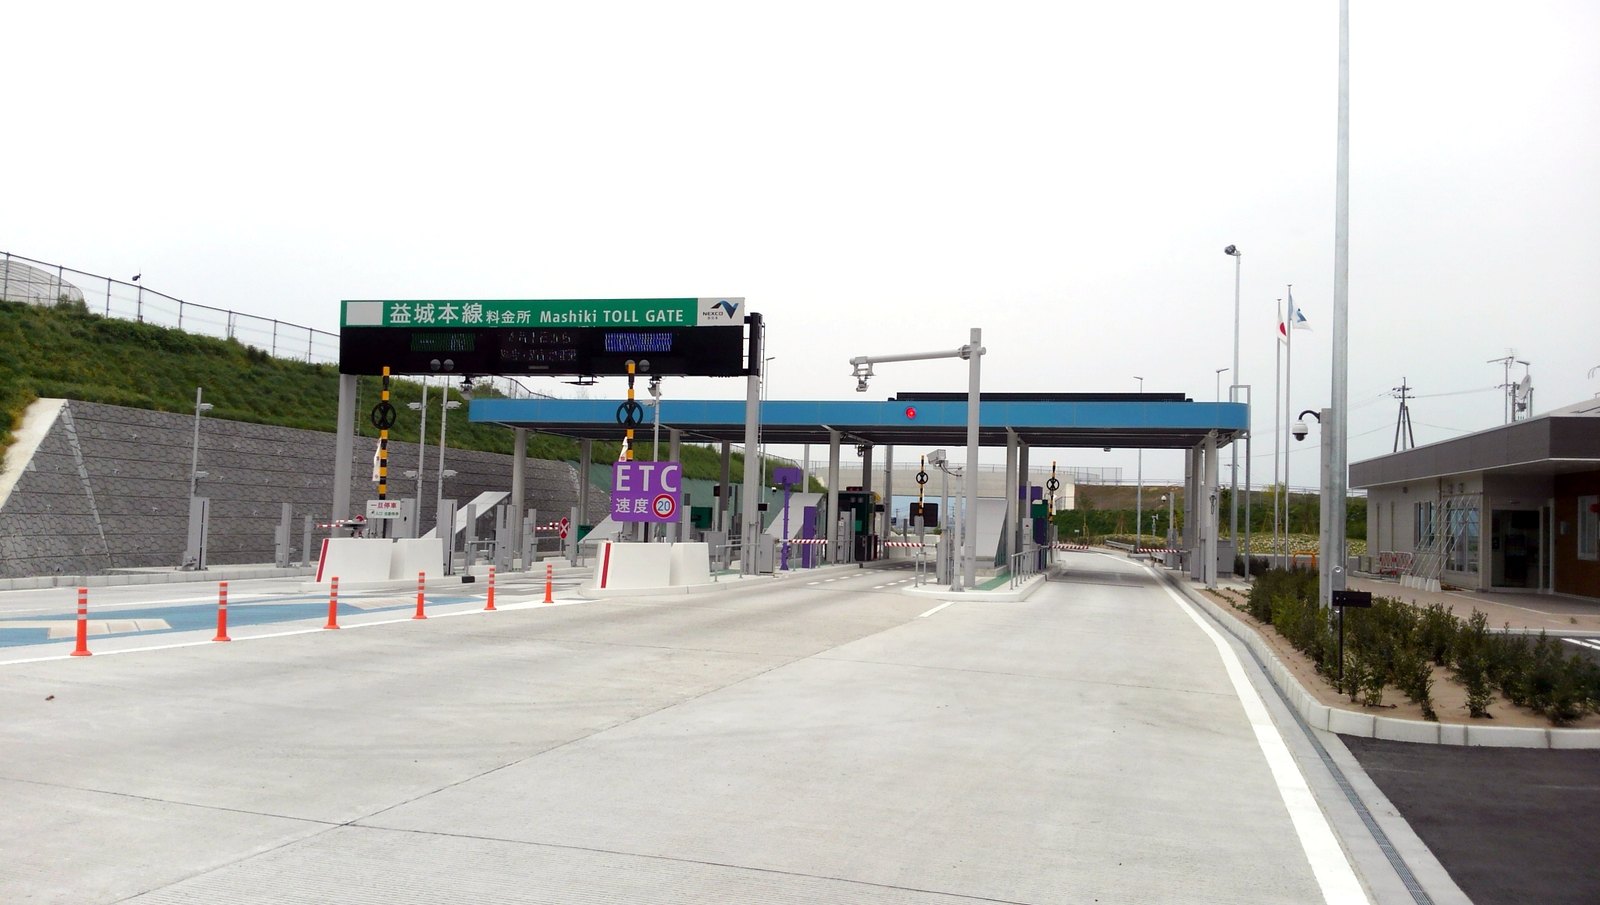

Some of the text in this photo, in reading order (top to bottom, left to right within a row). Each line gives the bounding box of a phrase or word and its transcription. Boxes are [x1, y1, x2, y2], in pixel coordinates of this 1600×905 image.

[539, 309, 597, 323] Mashiki
[603, 309, 639, 323] TOLL
[645, 308, 684, 323] GATE
[616, 465, 678, 492] ETC
[615, 498, 671, 513] 速度 20
